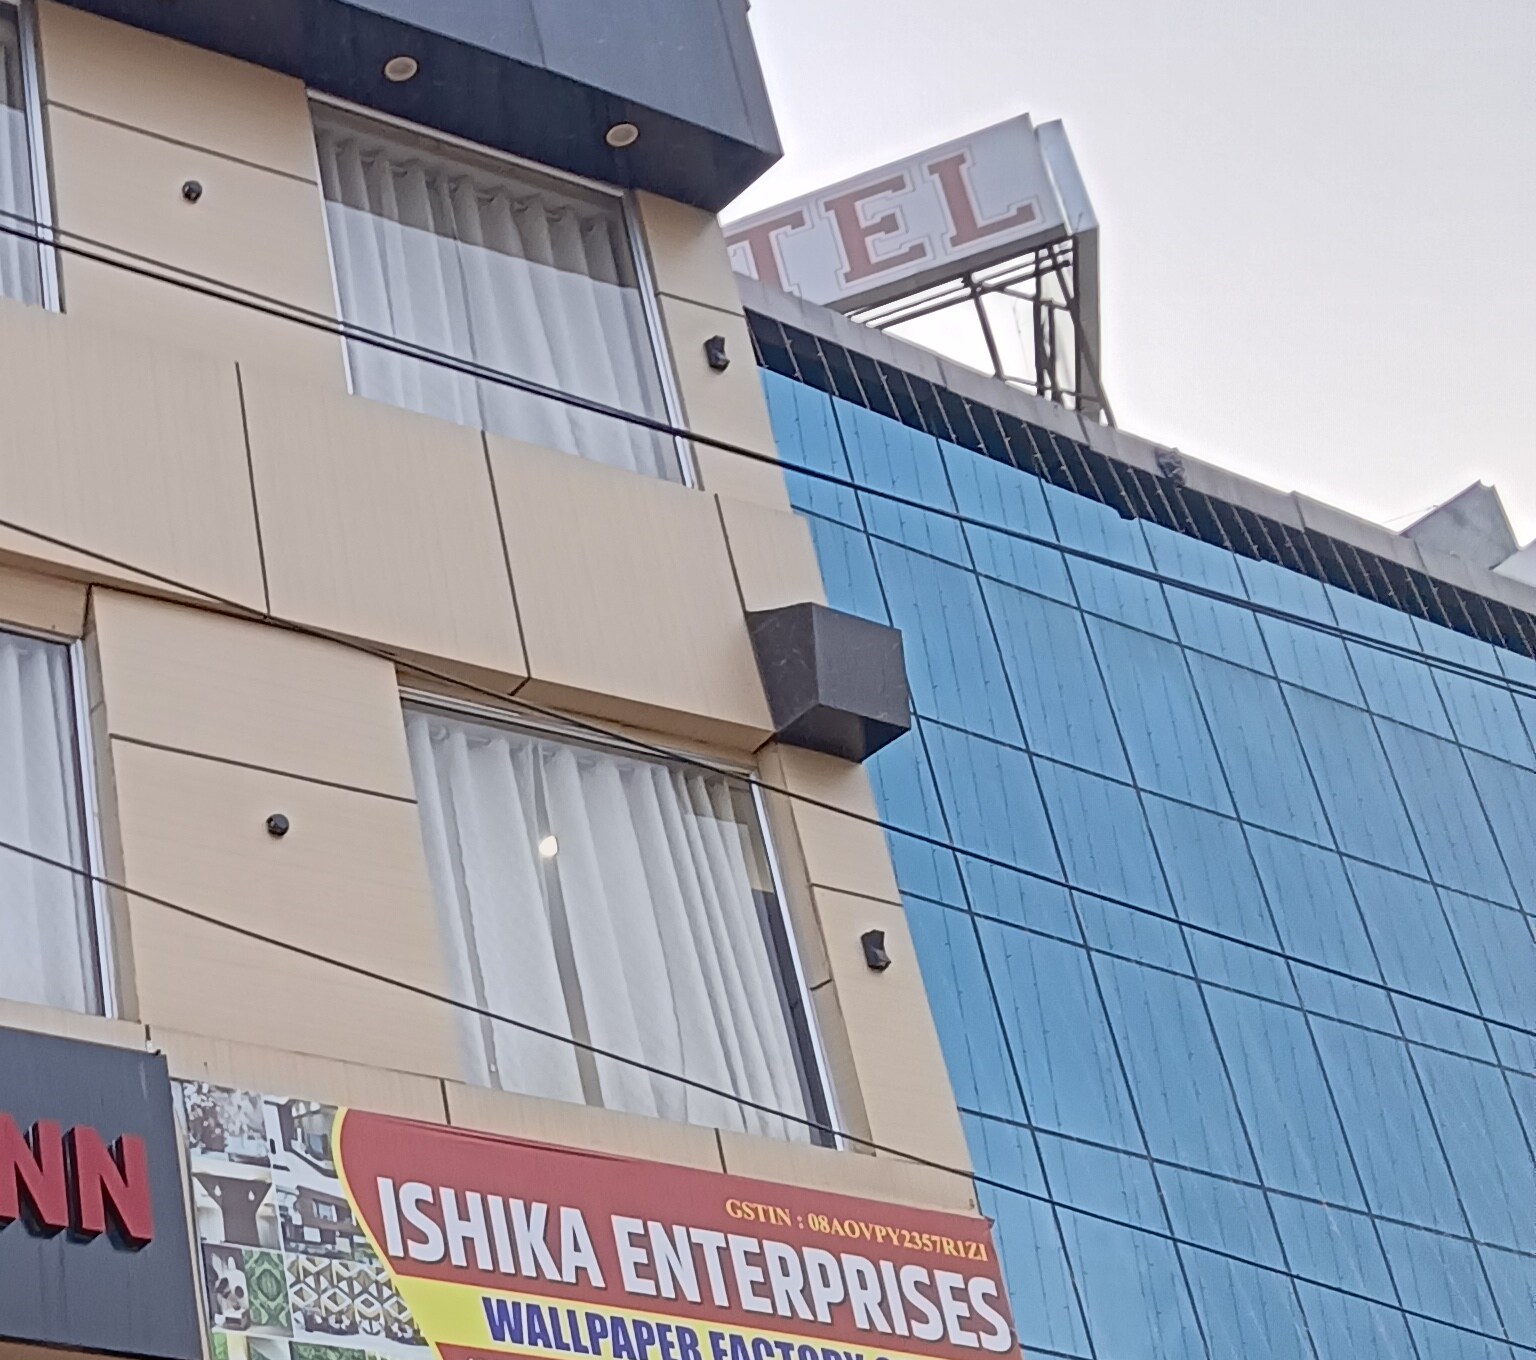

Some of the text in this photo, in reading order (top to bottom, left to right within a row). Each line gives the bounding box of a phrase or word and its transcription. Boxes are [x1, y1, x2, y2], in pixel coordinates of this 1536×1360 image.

[724, 151, 1037, 289] TEL
[376, 1176, 1013, 1353] ISHIKA ENTERPRISES
[725, 1198, 792, 1228] GSTIN
